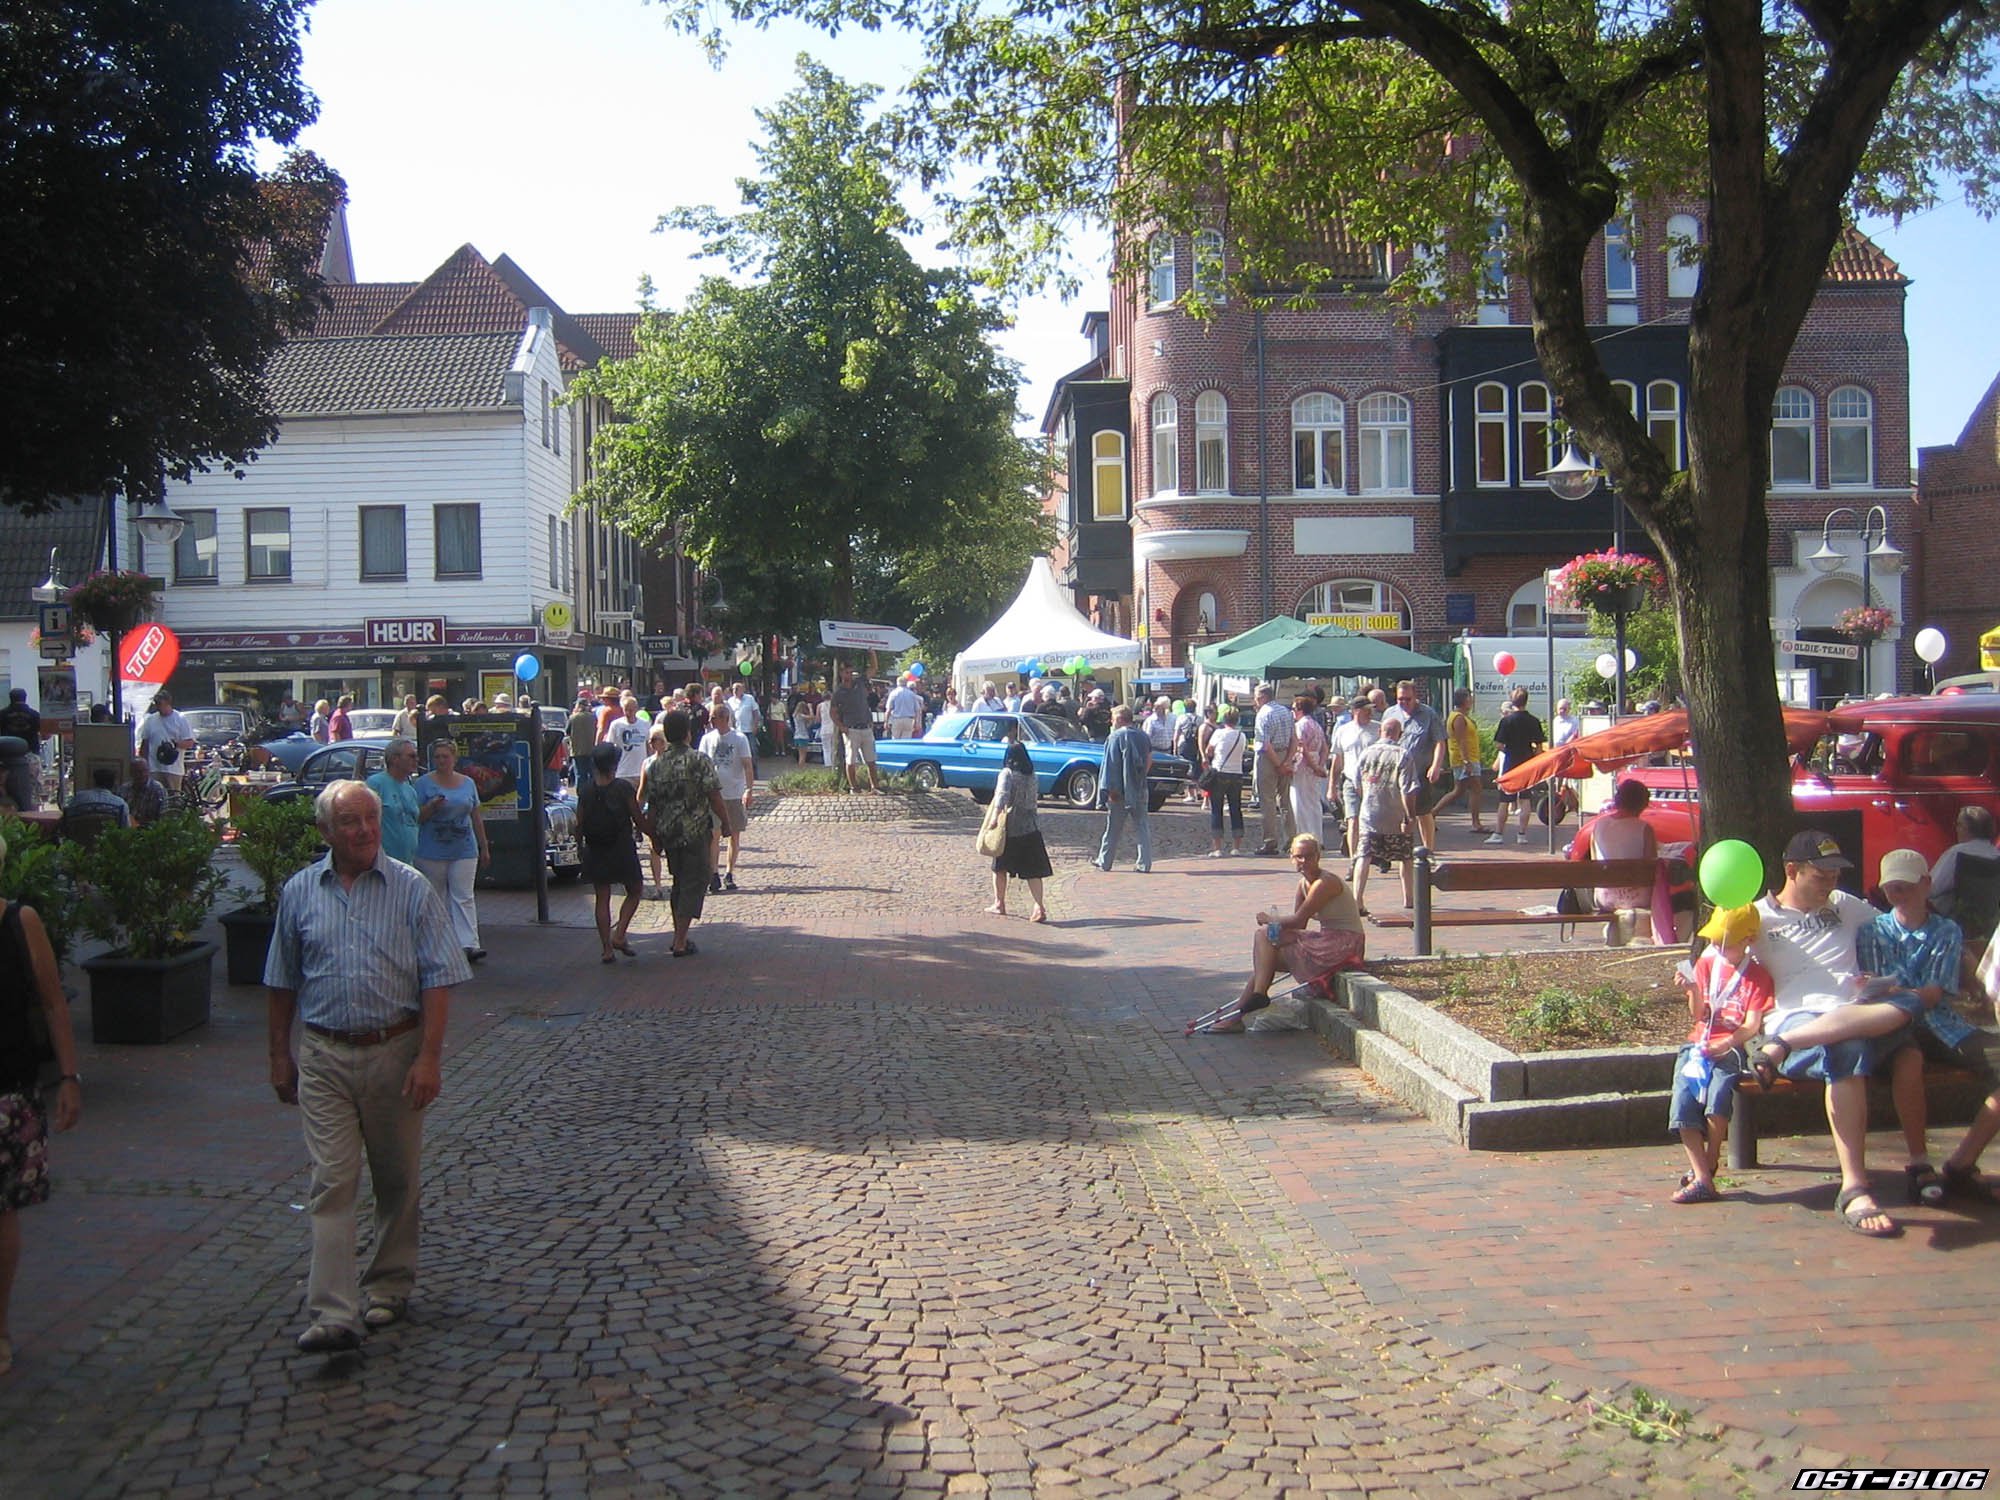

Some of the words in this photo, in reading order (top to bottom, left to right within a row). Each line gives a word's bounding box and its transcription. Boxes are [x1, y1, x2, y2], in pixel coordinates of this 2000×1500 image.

[1367, 614, 1398, 630] BODE
[373, 622, 437, 643] HEUER
[125, 625, 166, 678] TGB
[648, 641, 671, 649] KIND
[1794, 643, 1846, 656] OLDIE-TEAM
[1474, 681, 1504, 691] Reifen
